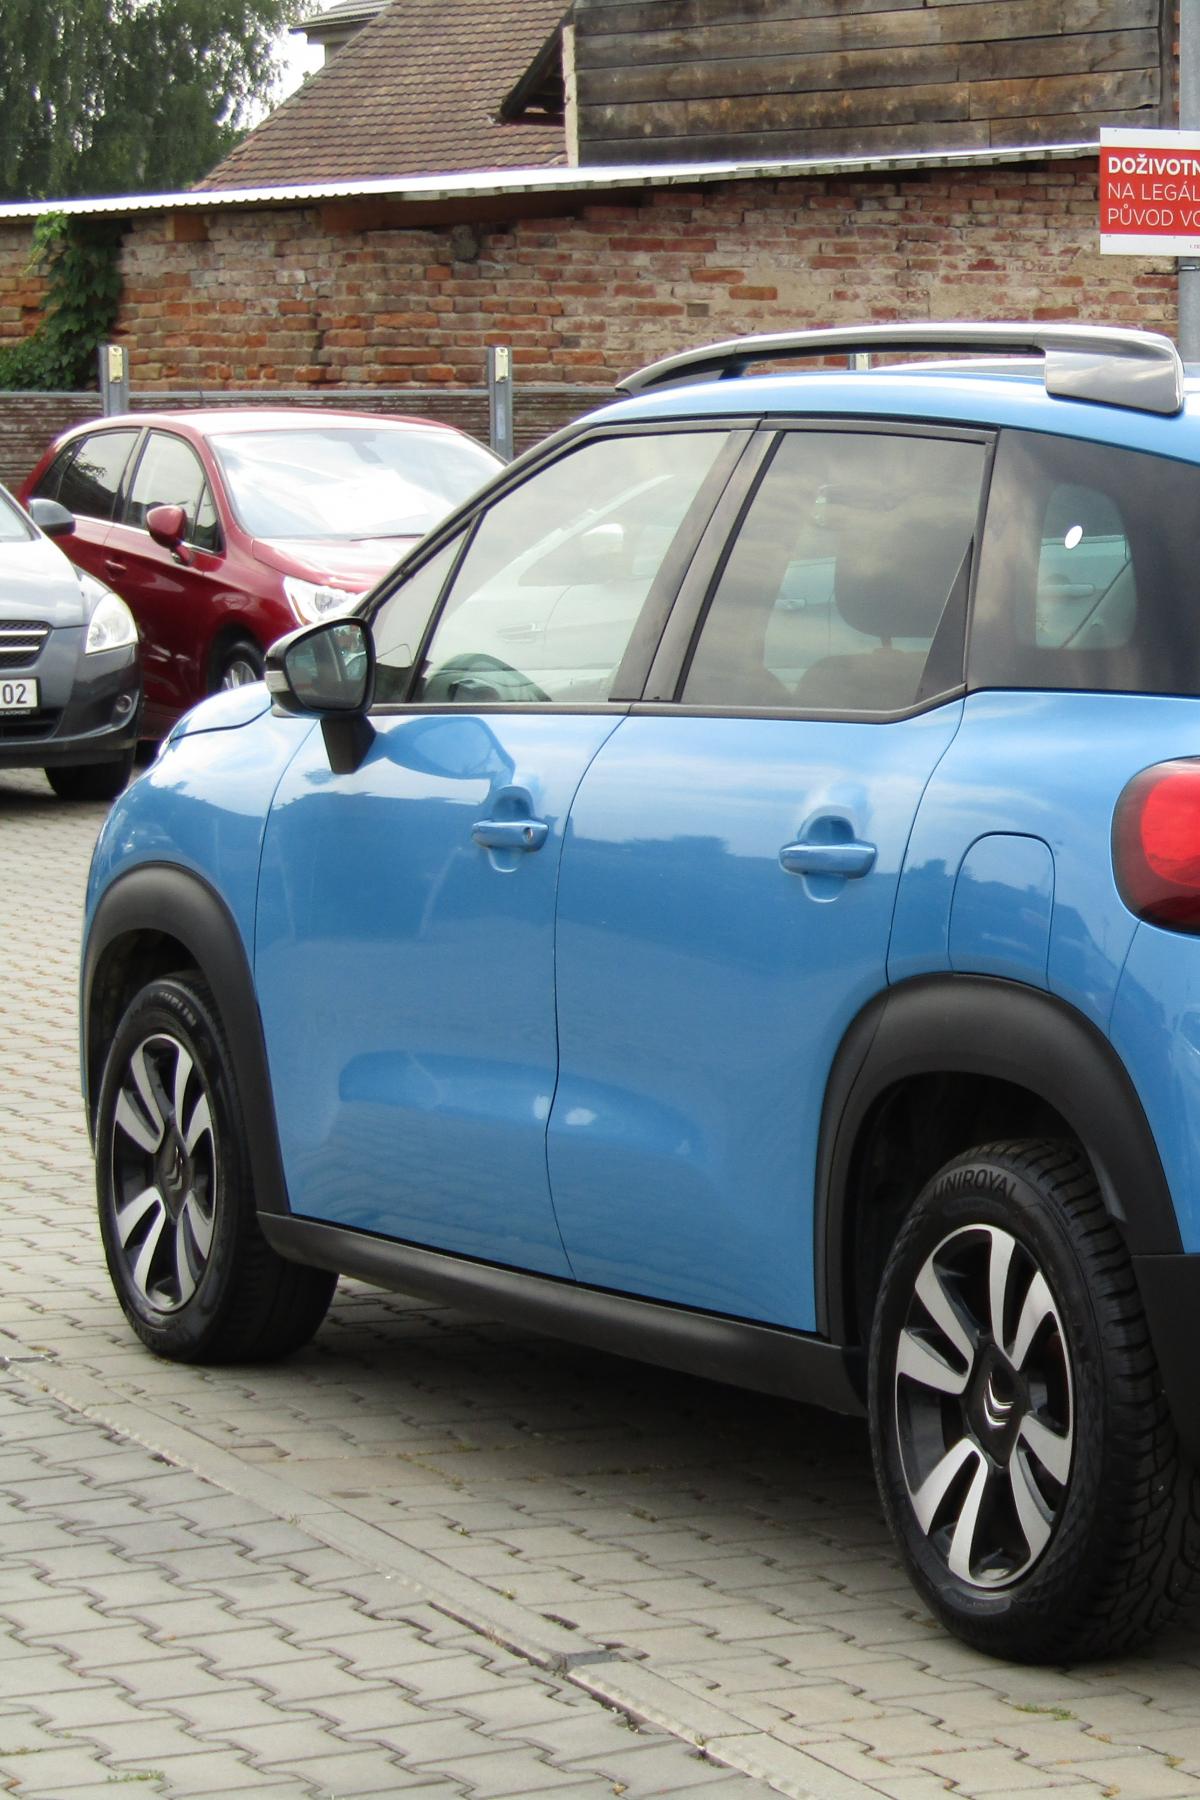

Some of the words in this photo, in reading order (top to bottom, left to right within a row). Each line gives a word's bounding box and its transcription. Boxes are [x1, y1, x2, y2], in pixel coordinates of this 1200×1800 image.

[1107, 182, 1135, 200] NA
[1107, 203, 1174, 227] PŮVOD
[932, 1168, 1017, 1201] UNIROYAL
